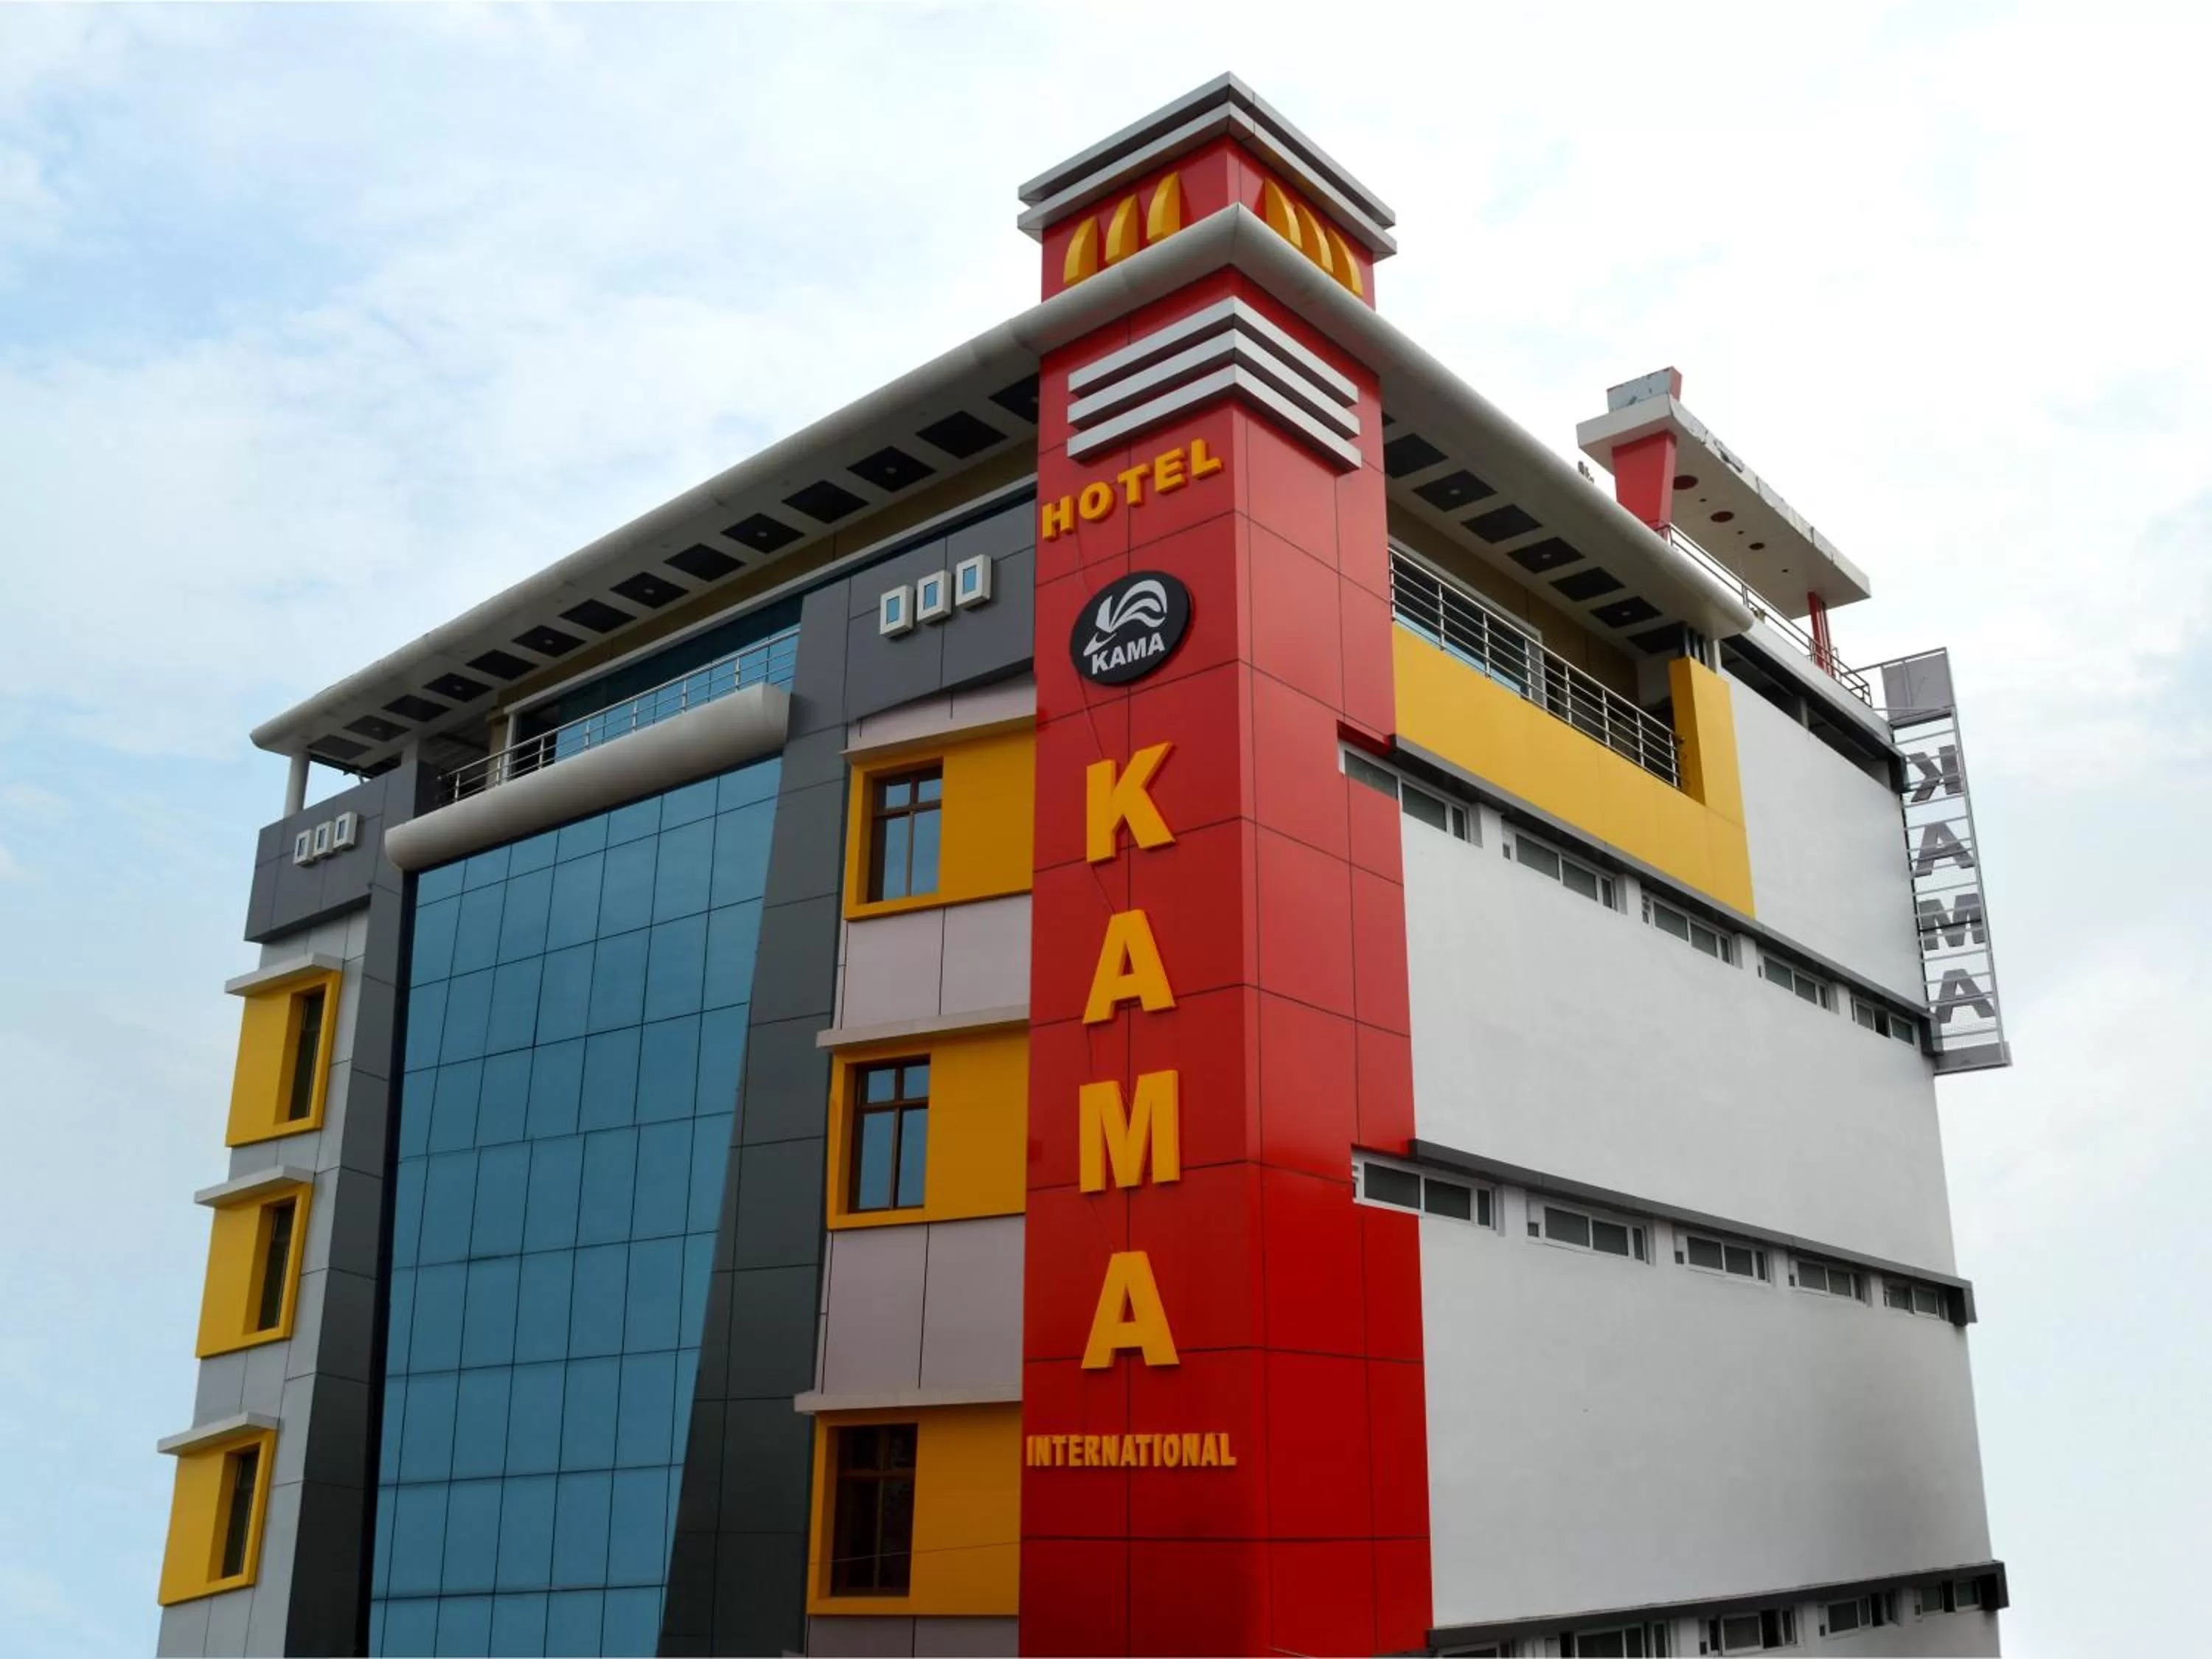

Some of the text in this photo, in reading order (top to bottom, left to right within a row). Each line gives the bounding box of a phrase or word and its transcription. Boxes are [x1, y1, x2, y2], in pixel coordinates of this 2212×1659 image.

[1041, 439, 1222, 540] HOTEL
[1091, 632, 1166, 675] KAMA
[1079, 741, 1180, 1369] KAMA
[1026, 1433, 1237, 1467] INTERNATIONAL
